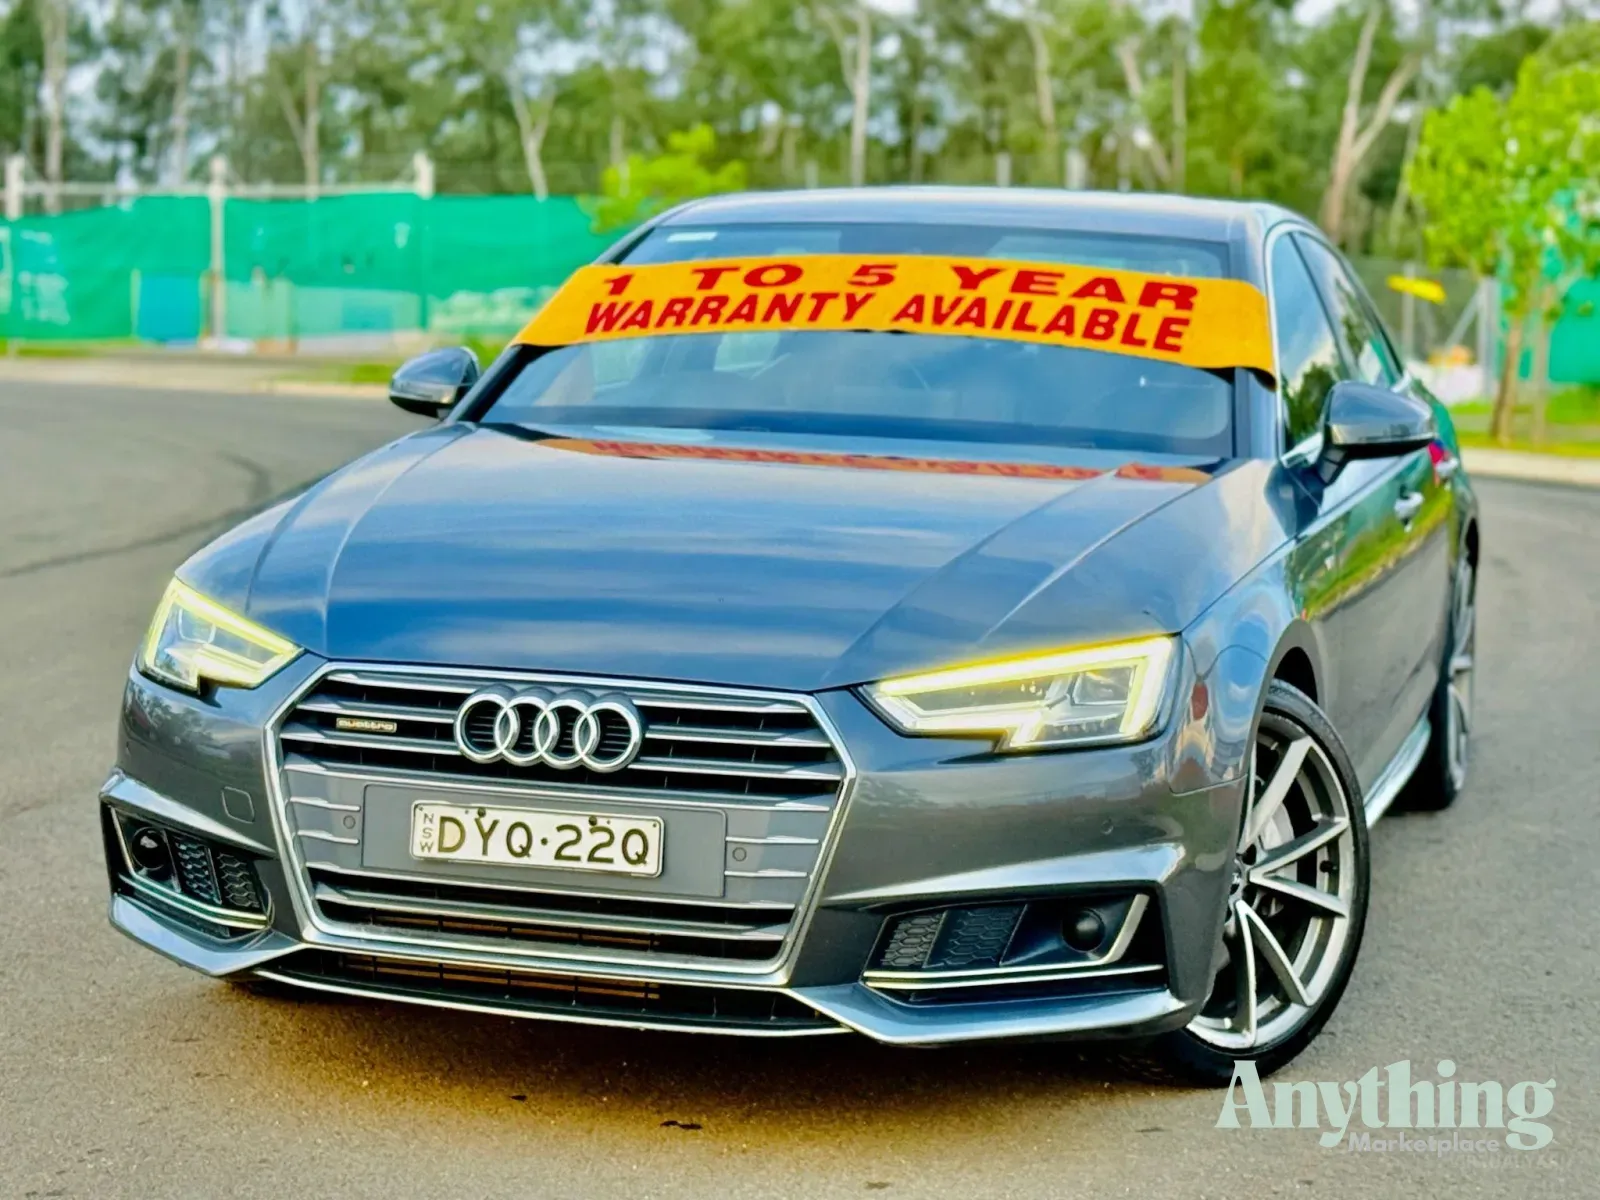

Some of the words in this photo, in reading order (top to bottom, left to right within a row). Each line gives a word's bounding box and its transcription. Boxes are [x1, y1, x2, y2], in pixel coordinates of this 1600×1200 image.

[603, 273, 635, 296] 1
[691, 263, 804, 288] TO
[847, 263, 898, 287] 5
[950, 265, 1199, 311] YEAR
[584, 291, 876, 335] WARRANTY
[890, 294, 1191, 353] AVAILABLE
[419, 812, 435, 854] NSW
